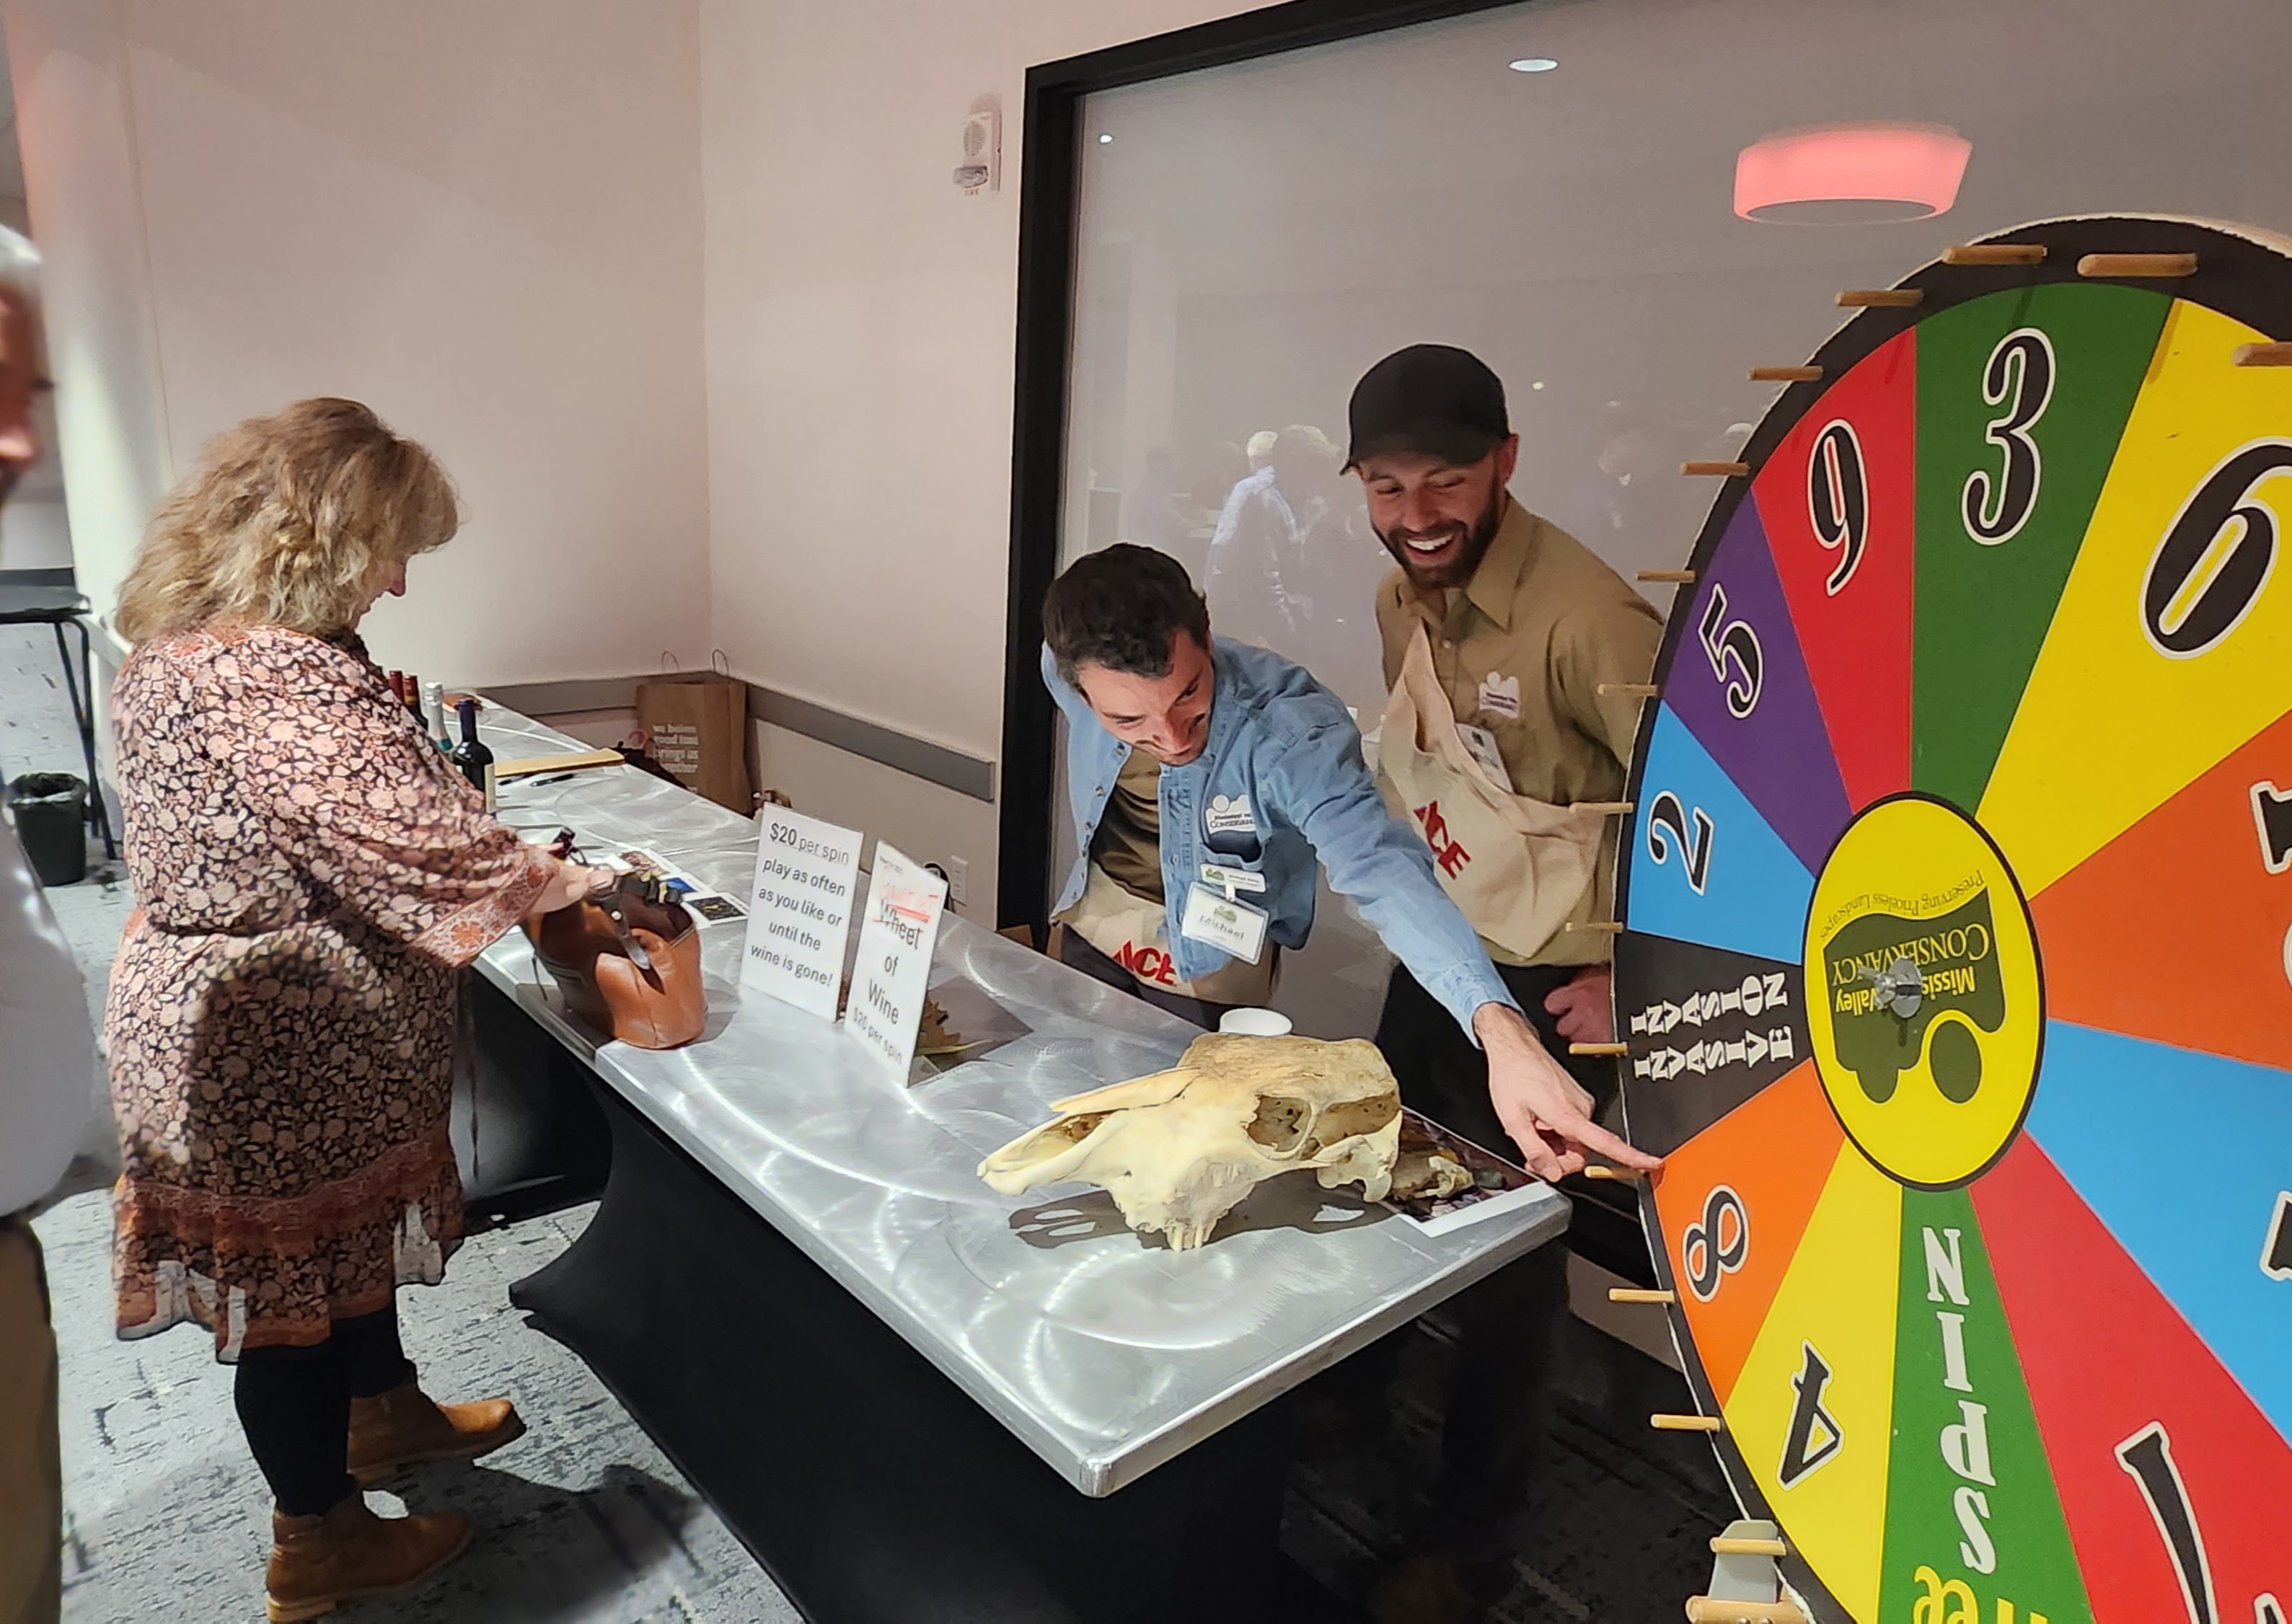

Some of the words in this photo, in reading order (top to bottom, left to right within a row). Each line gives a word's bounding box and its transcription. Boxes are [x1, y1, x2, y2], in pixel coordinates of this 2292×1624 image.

[1960, 327, 2056, 546] 3
[1807, 418, 1869, 597] 9
[2137, 435, 2292, 661] 6
[1697, 582, 1764, 719] 5
[769, 821, 797, 846] $20
[799, 837, 820, 857] per
[822, 845, 850, 864] spin
[1414, 800, 1471, 881] ACE
[1647, 790, 1715, 896] 2
[762, 858, 790, 883] play
[793, 868, 807, 881] as
[811, 872, 846, 896] often
[1921, 870, 1984, 911] Preserving
[759, 888, 773, 900] as
[775, 893, 798, 914] you
[801, 899, 825, 921] like
[828, 914, 842, 927] or
[880, 898, 922, 950] Wheel
[1199, 914, 1245, 940] Michael
[1820, 894, 1869, 941] Landscapes
[1872, 893, 1919, 916] Priceless
[769, 922, 797, 945] until
[800, 932, 821, 951] the
[751, 944, 779, 966] wine
[783, 955, 793, 971] is
[795, 962, 834, 988] gone!
[884, 956, 899, 976] of
[1113, 940, 1177, 987] ACE
[1921, 966, 1975, 1000] Missis
[868, 979, 899, 1025] Wine
[1630, 971, 1789, 1036] INVASION
[853, 1007, 868, 1031] $20
[868, 1024, 883, 1045] per
[883, 1041, 902, 1065] spin
[1634, 1025, 1794, 1081] INVASIVE
[1683, 1184, 1750, 1302] 8
[1776, 1337, 1846, 1492] 4
